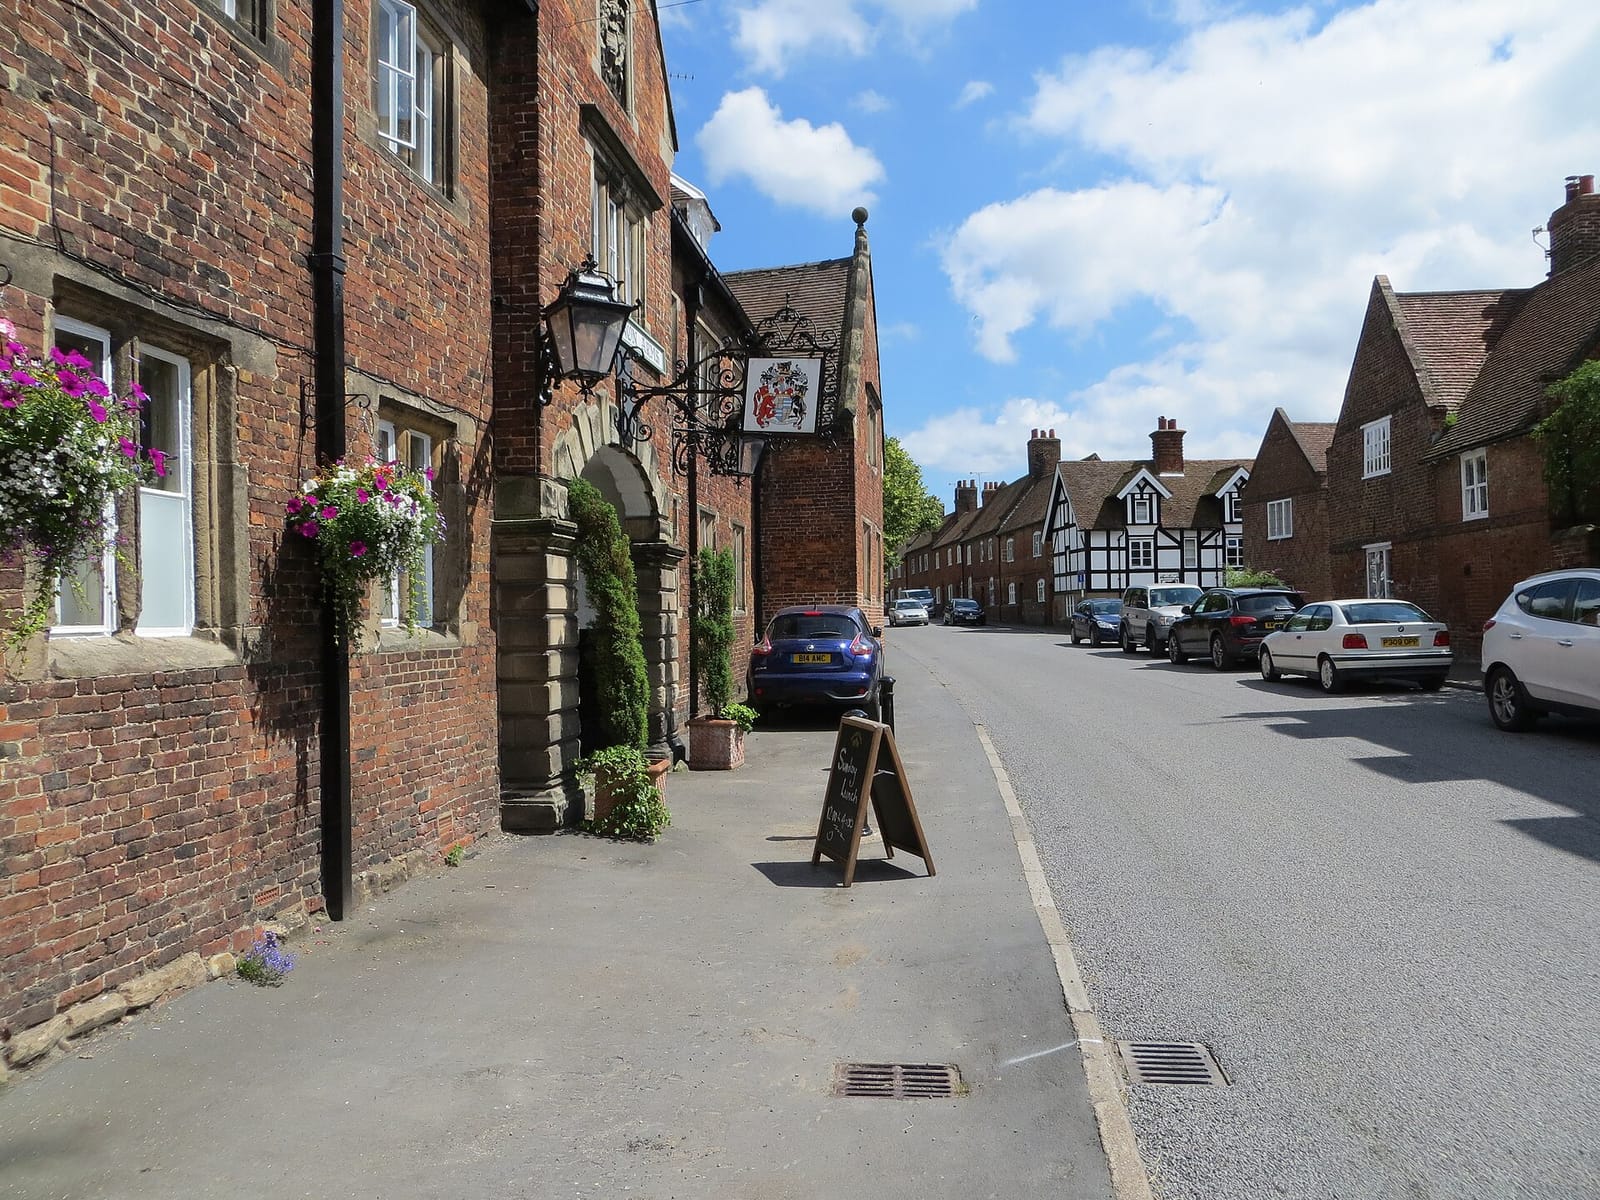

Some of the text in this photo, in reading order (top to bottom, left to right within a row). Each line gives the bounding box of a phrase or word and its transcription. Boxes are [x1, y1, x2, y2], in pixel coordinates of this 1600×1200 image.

[812, 653, 826, 662] AMC
[837, 747, 858, 788] Sunday
[840, 777, 858, 804] Lunch
